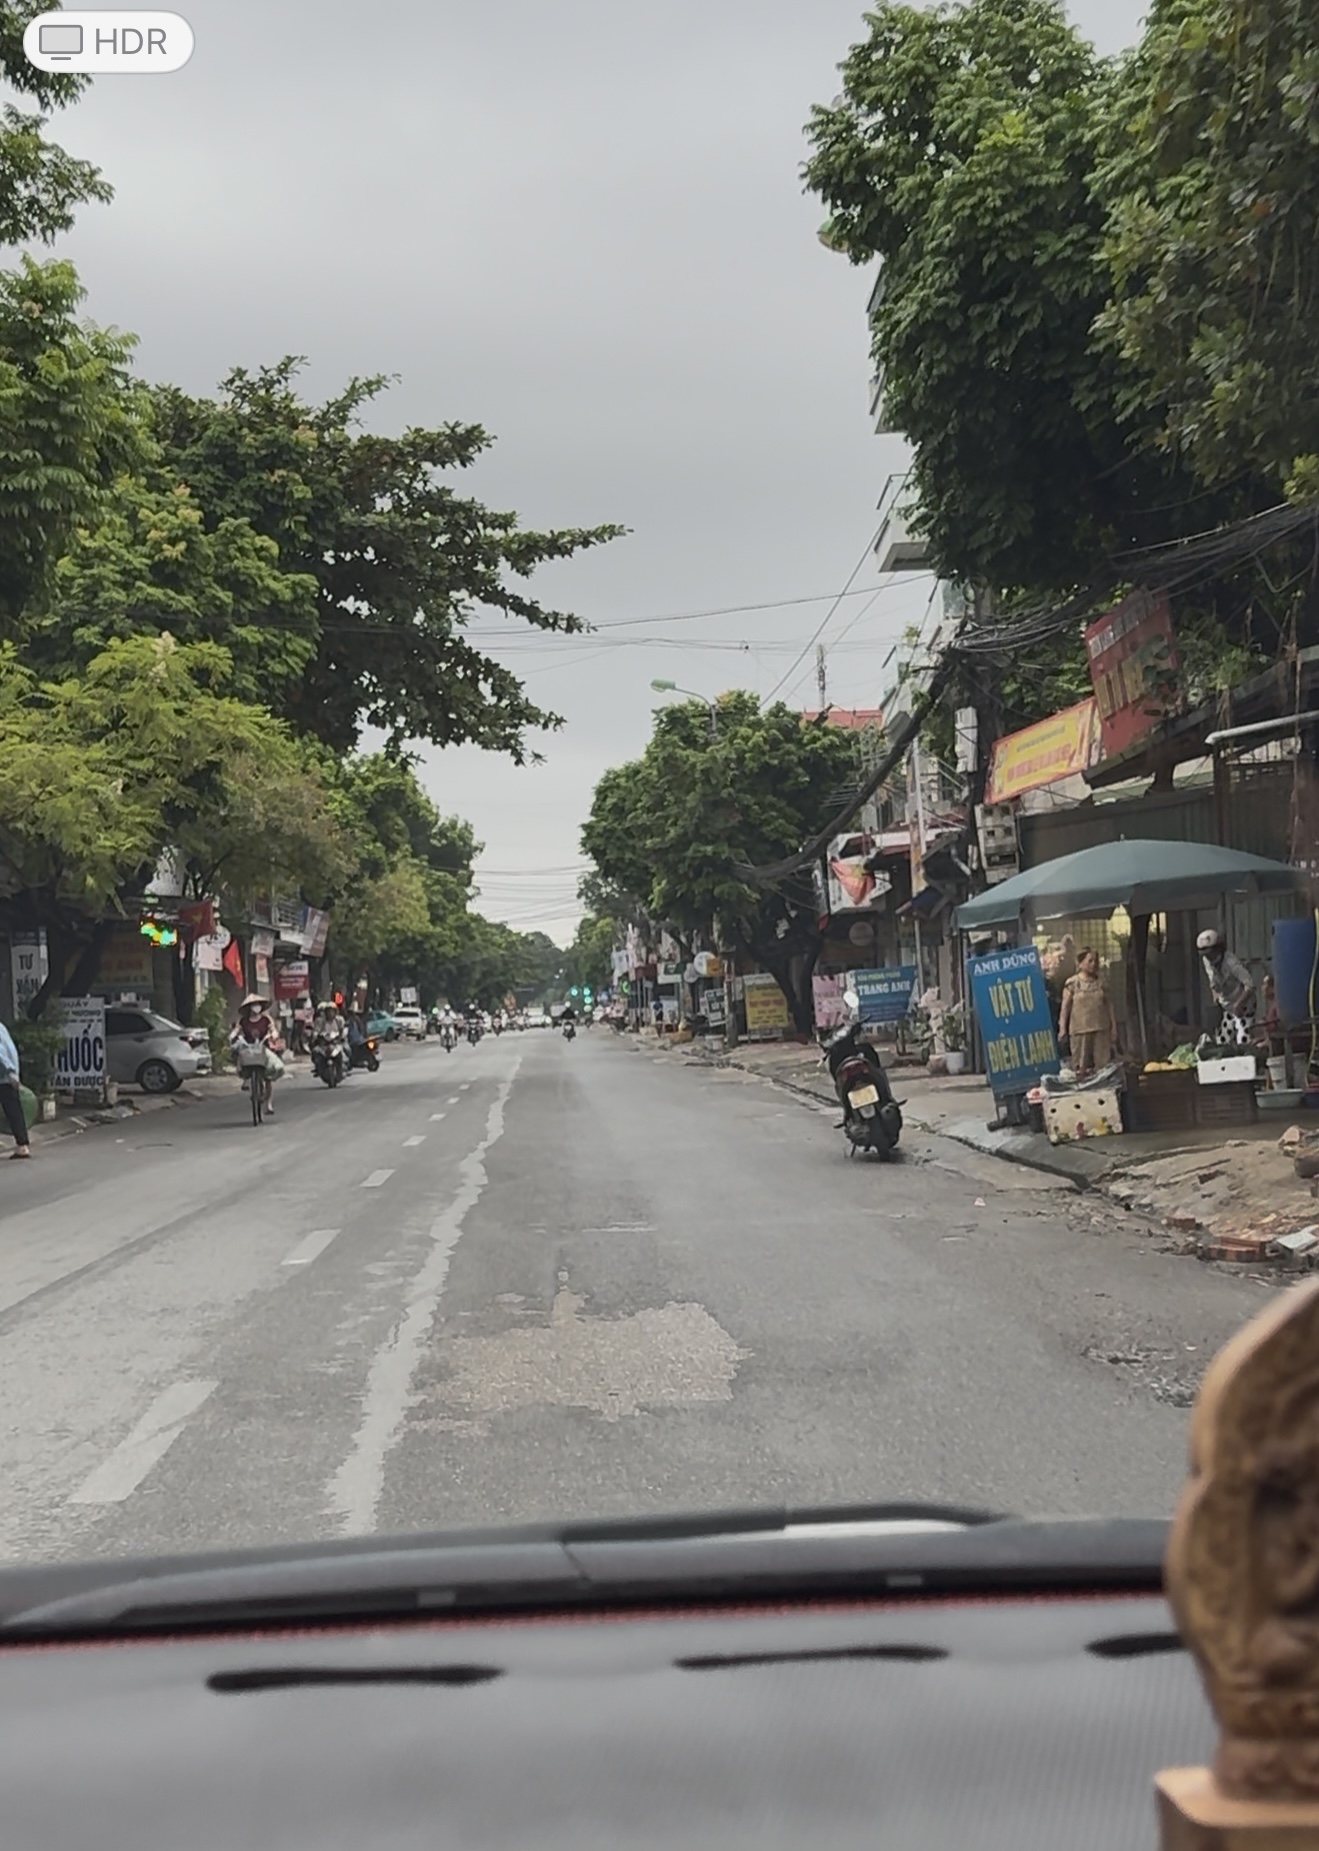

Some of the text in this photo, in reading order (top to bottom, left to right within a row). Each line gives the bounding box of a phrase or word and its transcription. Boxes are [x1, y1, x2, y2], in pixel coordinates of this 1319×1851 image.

[973, 952, 1037, 976] ANH DŨNG
[988, 975, 1034, 1025] VẬT TƯ
